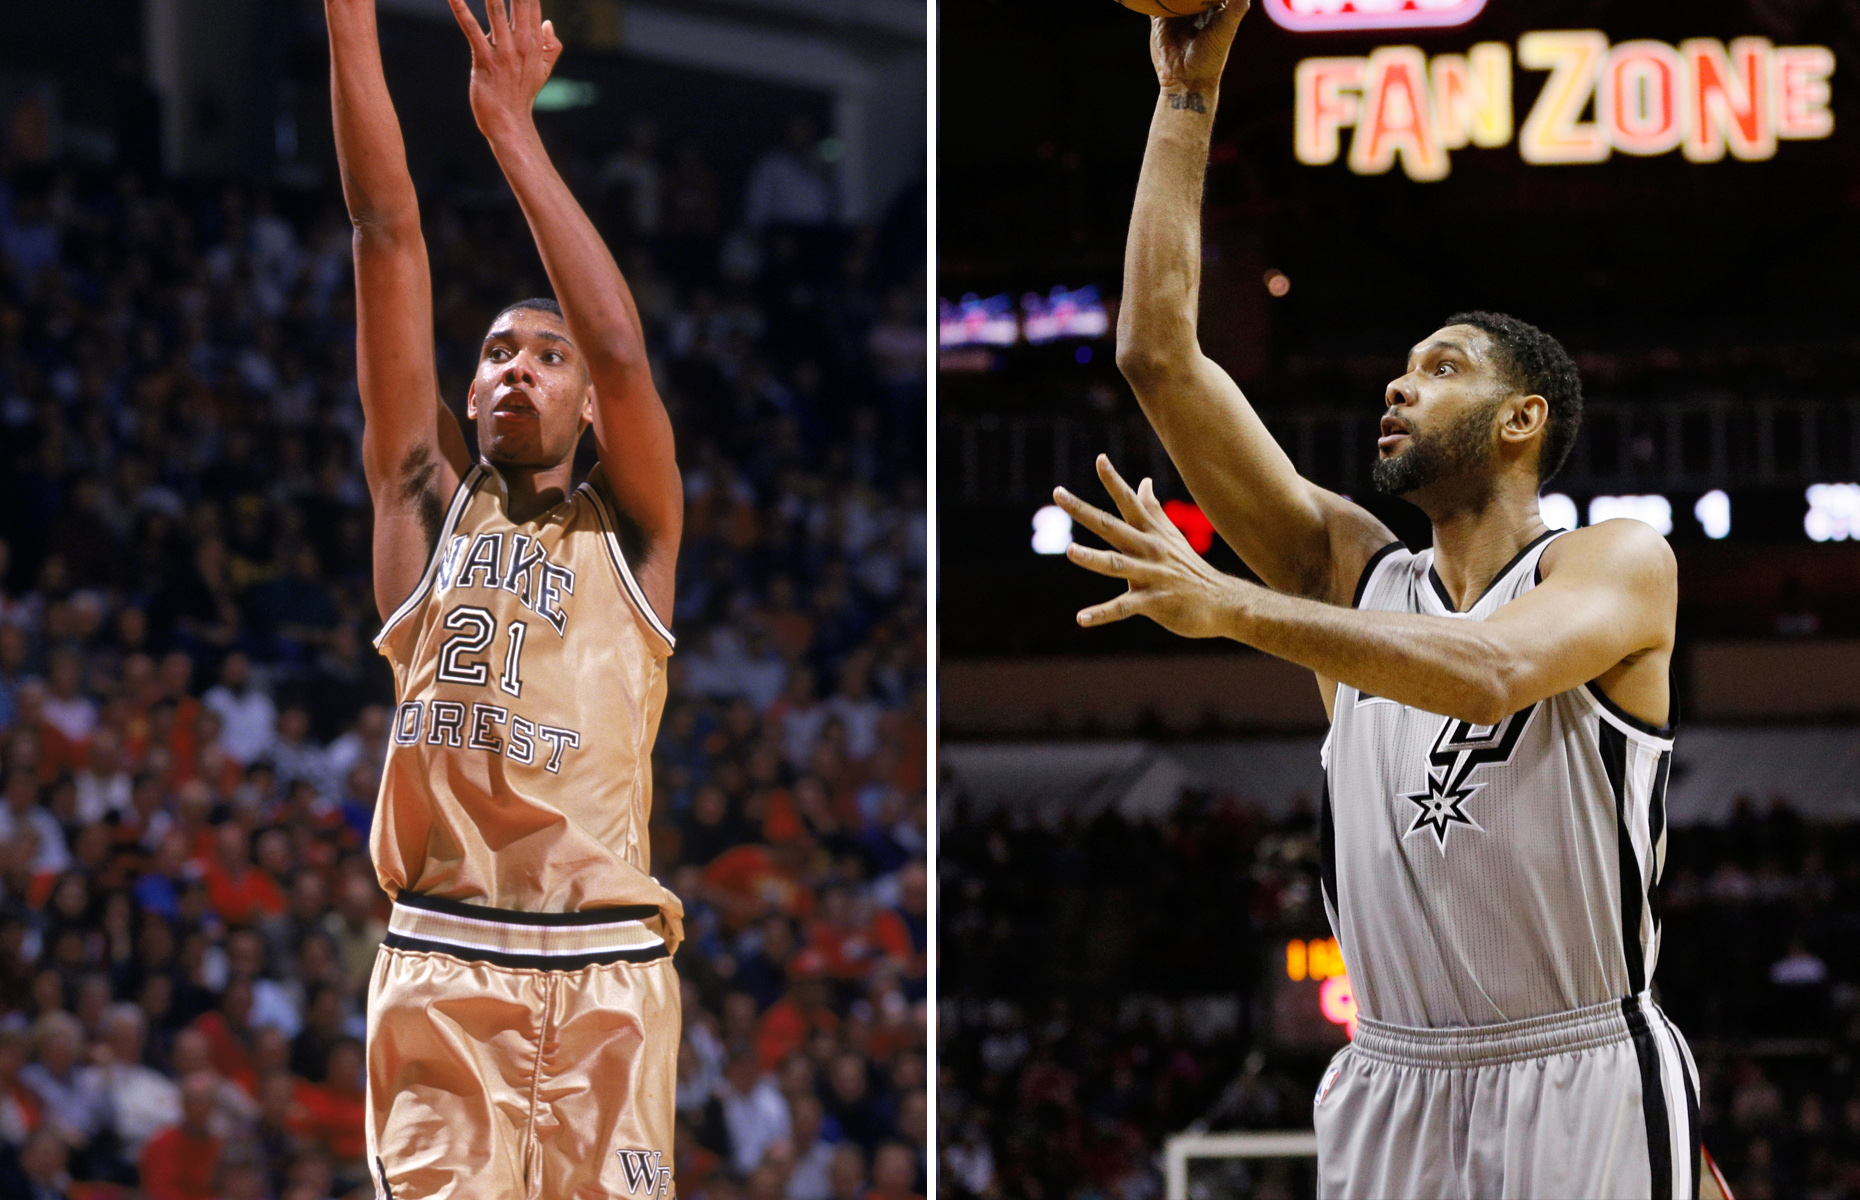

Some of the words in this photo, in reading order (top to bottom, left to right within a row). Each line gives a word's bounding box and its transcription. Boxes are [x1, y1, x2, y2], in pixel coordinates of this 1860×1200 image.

[1294, 41, 1513, 182] FAN
[1517, 29, 1836, 165] ZONE
[436, 604, 527, 699] 21
